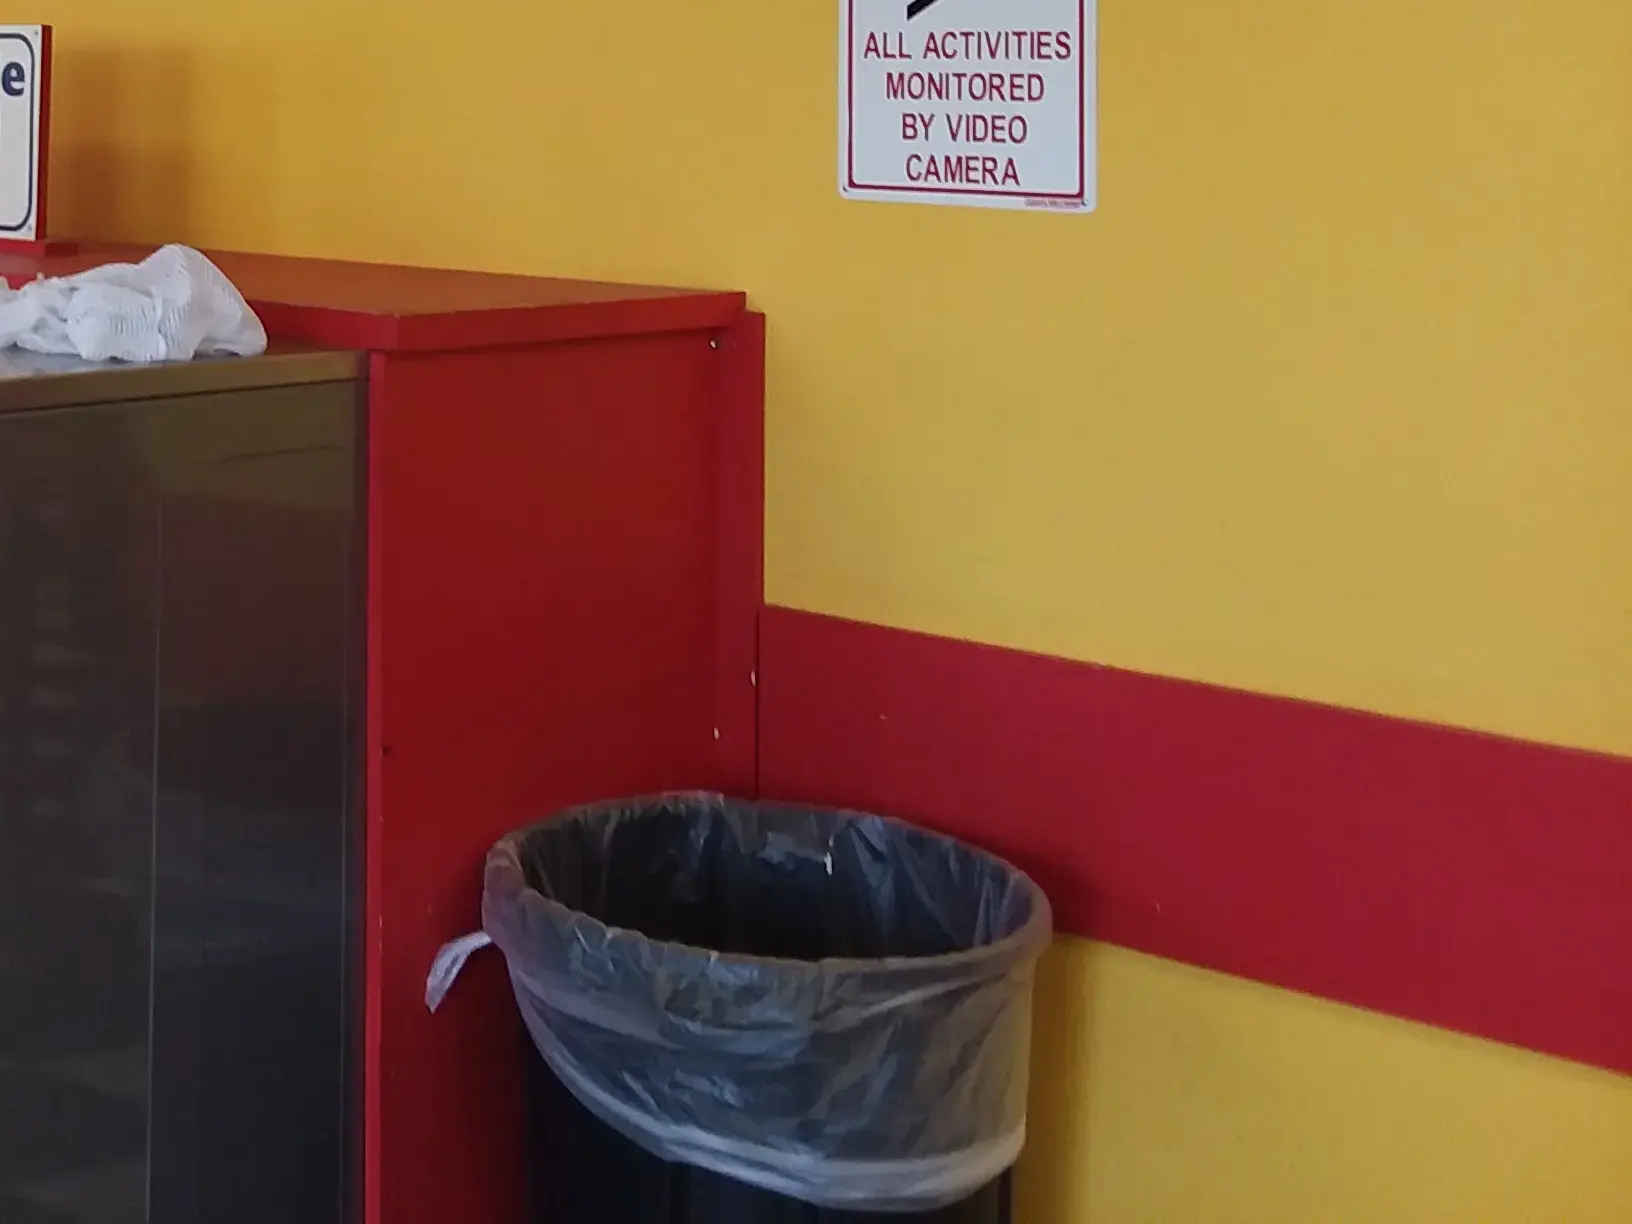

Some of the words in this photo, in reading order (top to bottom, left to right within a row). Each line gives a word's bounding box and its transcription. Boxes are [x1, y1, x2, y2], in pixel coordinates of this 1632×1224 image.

[863, 31, 913, 60] ALL
[922, 31, 1072, 60] ACTIVITIES
[886, 72, 1045, 102] MONITORED
[902, 113, 936, 141] BY
[946, 114, 1028, 145] VIDEO
[906, 154, 1021, 187] CAMERA
